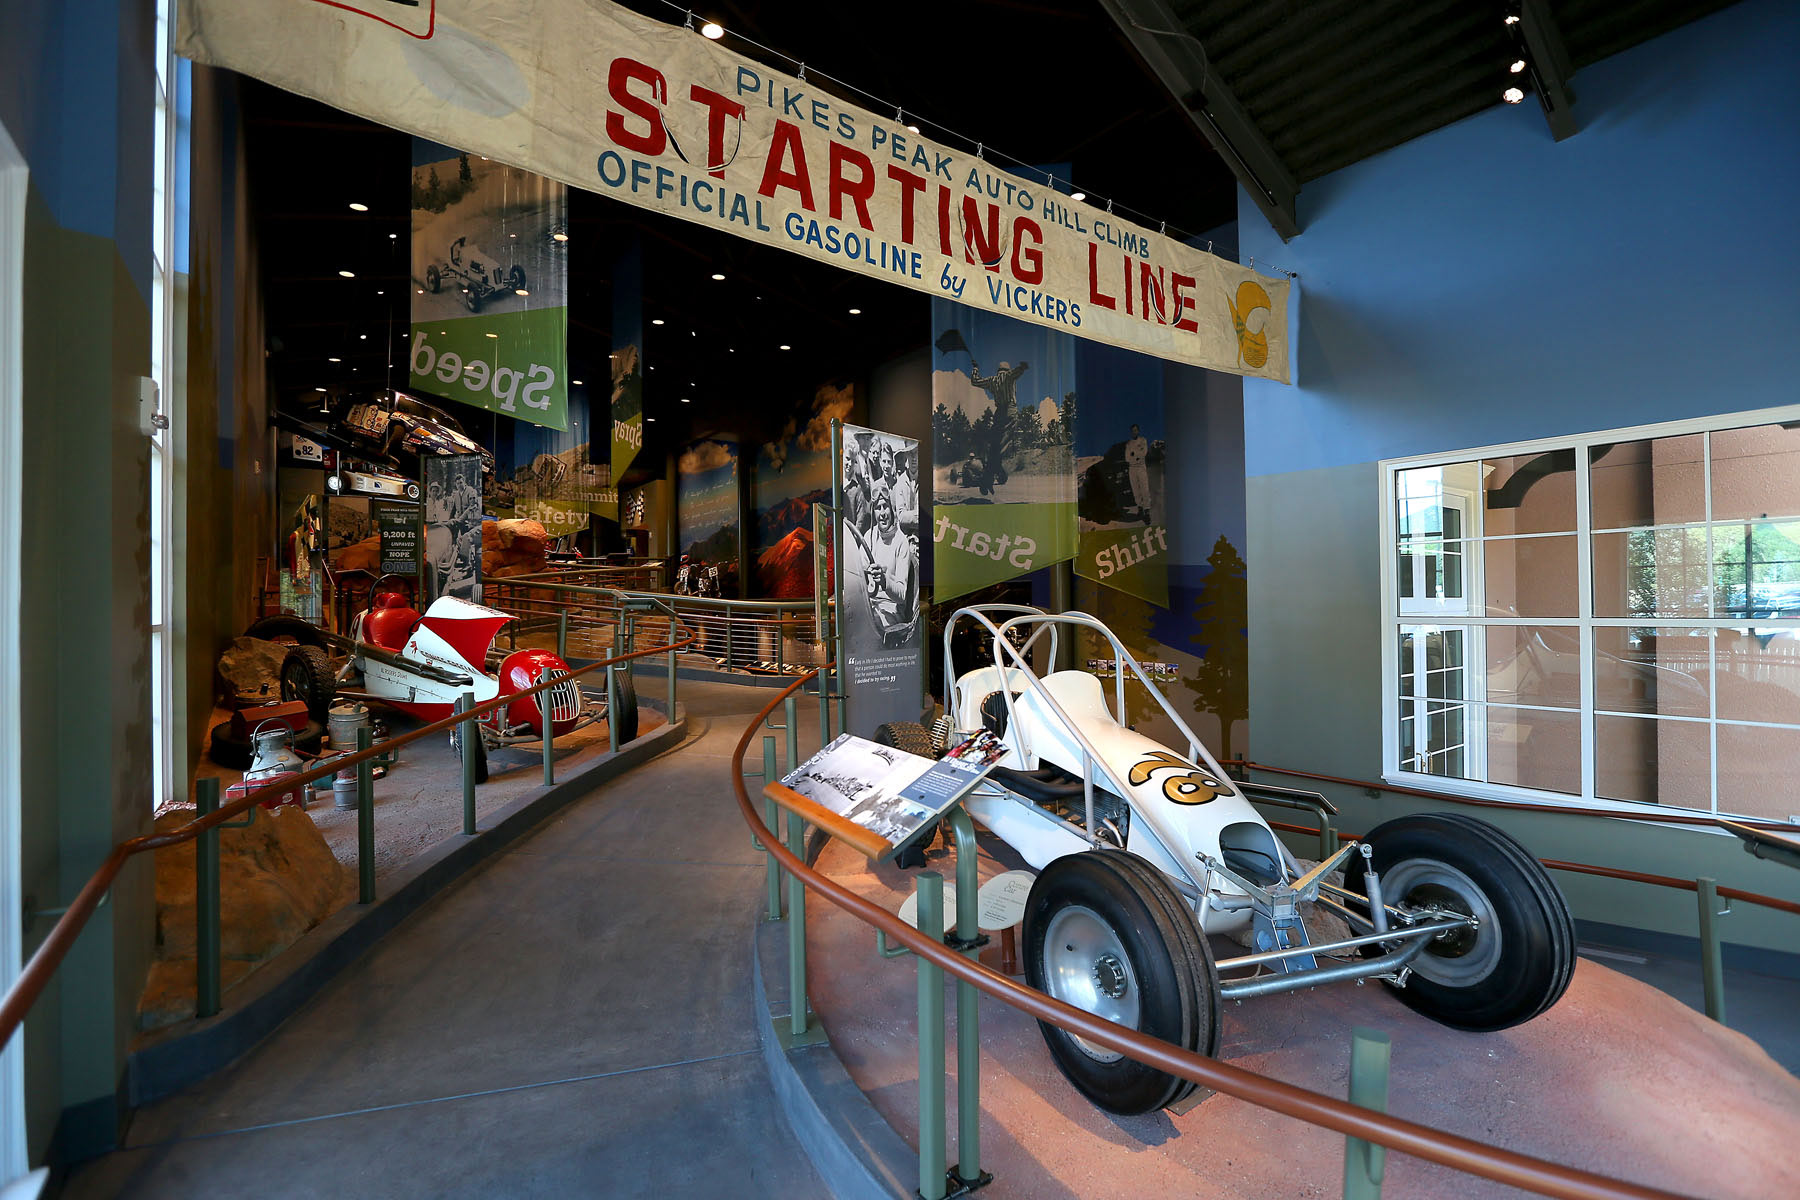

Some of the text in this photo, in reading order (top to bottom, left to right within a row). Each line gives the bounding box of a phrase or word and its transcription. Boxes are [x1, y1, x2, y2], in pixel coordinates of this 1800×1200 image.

[737, 65, 1149, 259] PIKES PEAK AUTO HILL CLIMB
[605, 57, 1199, 334] STARTING LINE
[597, 151, 1082, 327] OFFICIAL GASOLINE by VICKER'S
[383, 531, 406, 539] 9,200
[515, 504, 590, 529] Safety
[381, 561, 417, 573] ONE
[1095, 526, 1167, 579] Shift
[1128, 751, 1236, 805] 78
